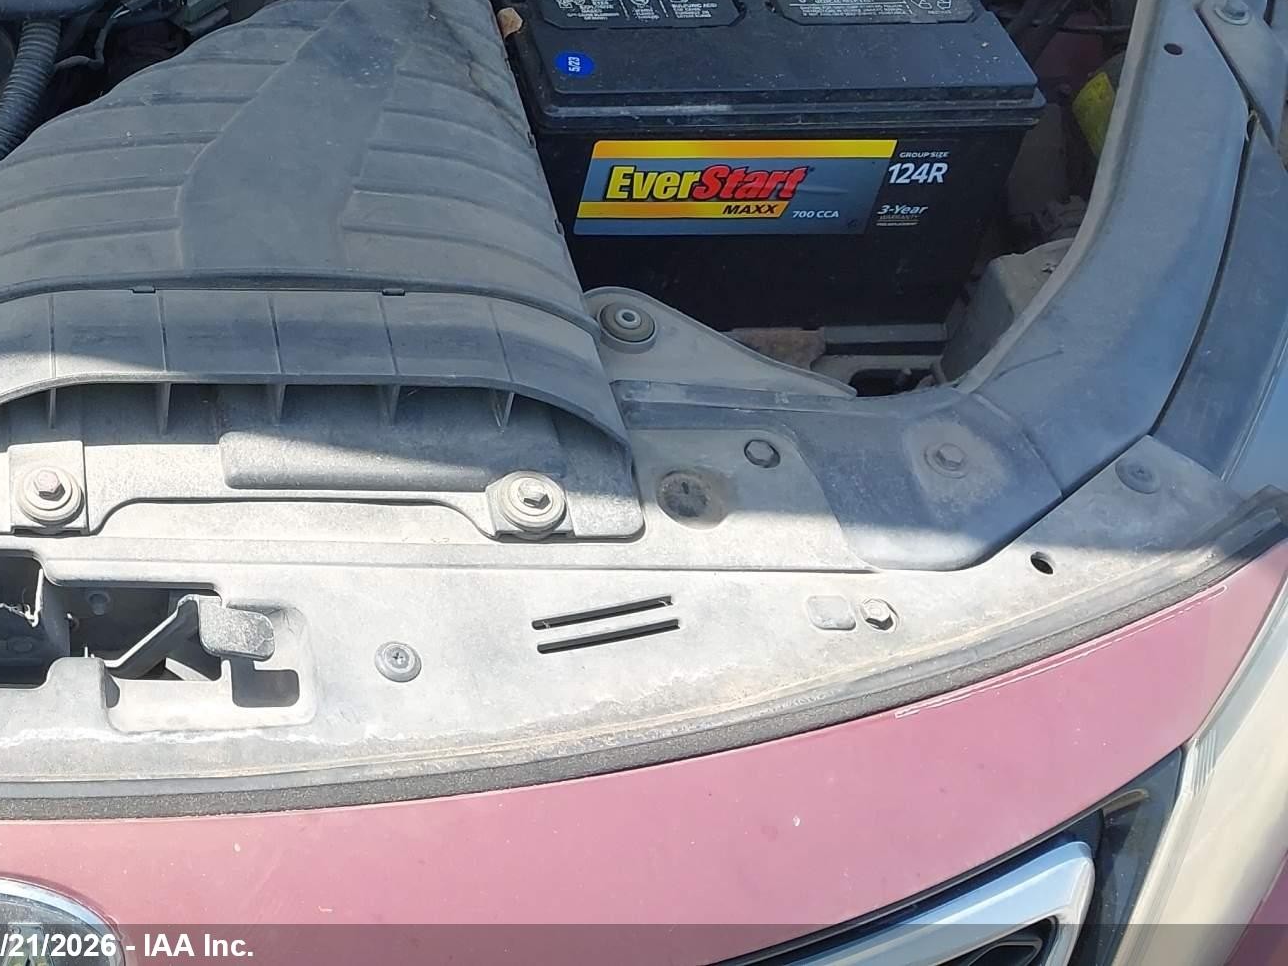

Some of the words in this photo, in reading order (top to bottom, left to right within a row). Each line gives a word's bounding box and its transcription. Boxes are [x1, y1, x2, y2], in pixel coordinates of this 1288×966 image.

[568, 56, 581, 72] 5/23
[888, 162, 949, 184] 124R
[606, 163, 810, 201] EverStart
[722, 203, 778, 215] MAXX
[792, 210, 815, 218] 700
[816, 210, 839, 218] CCA
[877, 205, 929, 215] 3-Year
